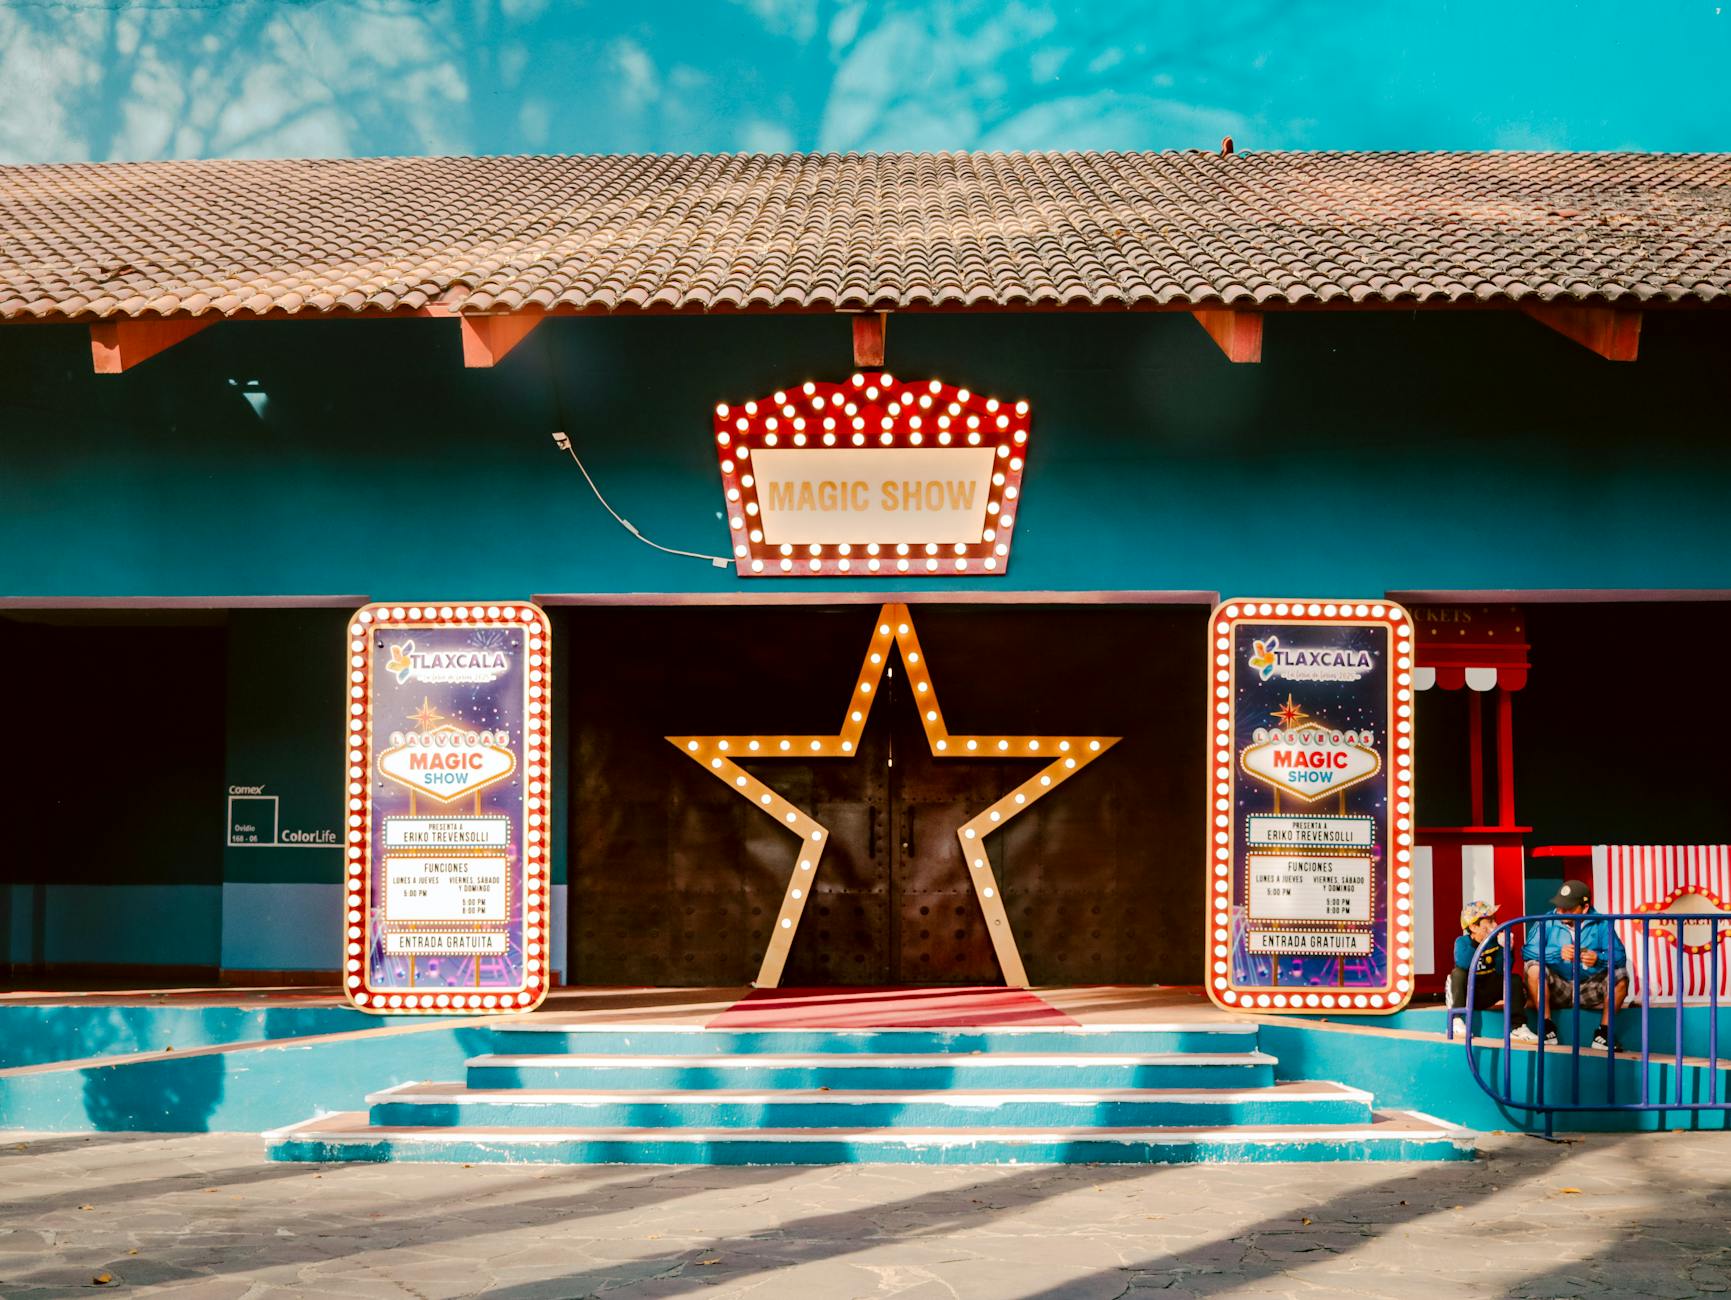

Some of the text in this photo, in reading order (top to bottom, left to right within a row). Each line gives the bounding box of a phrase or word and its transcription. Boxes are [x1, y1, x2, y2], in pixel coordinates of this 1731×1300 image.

[768, 480, 977, 511] MAGIC SHOW
[411, 652, 506, 669] TLAXCALA
[1274, 651, 1370, 667] TLAXCALA
[409, 752, 483, 770] MAGIC
[1273, 750, 1348, 769] MAGIC
[424, 773, 469, 784] SHOW
[1288, 771, 1333, 783] SHOW
[229, 784, 265, 794] Comex
[428, 823, 457, 831] PRESENTA
[1292, 822, 1322, 830] PRESENTA
[281, 829, 337, 843] ColorLife
[404, 832, 489, 842] ERIKO TREVENSOLLI
[1267, 830, 1353, 842] ERIKO TREVENSOLLI
[424, 863, 469, 873] FUNCIONES
[1288, 862, 1333, 872] FUNCIONES
[392, 876, 411, 884] LUNES
[418, 876, 439, 884] JUEVES
[1256, 875, 1274, 883] LUNES
[400, 936, 493, 948] ENTRADA GRATUITA
[1262, 935, 1357, 948] ENTRADA GRATUITA
